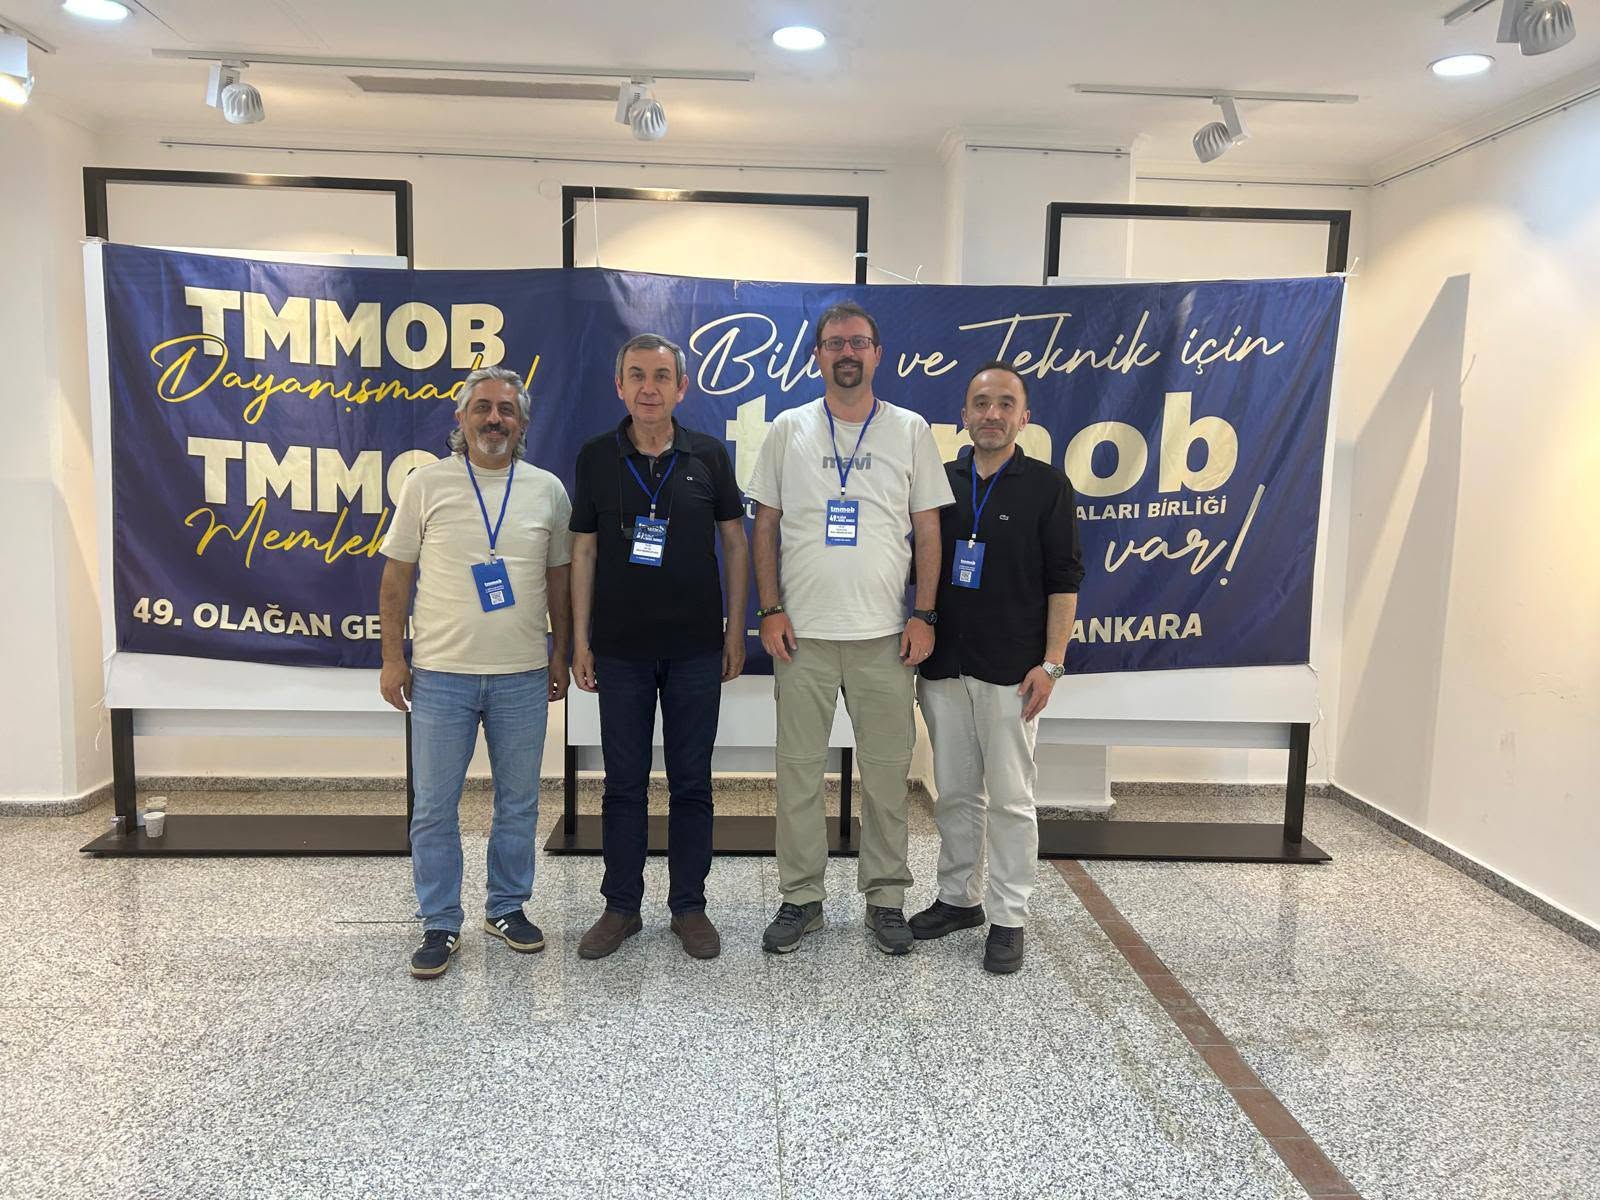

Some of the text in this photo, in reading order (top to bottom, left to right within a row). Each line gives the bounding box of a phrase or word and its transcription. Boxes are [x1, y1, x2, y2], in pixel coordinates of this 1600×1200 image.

[184, 285, 506, 370] TMMOB
[689, 310, 1285, 395] Bili ve Teknik için
[1104, 483, 1266, 587] var!
[1147, 495, 1227, 518] BİRLİĞİ
[132, 597, 183, 626] 49.
[192, 602, 333, 638] OLAĞAN
[1068, 612, 1204, 645] ANKARA
